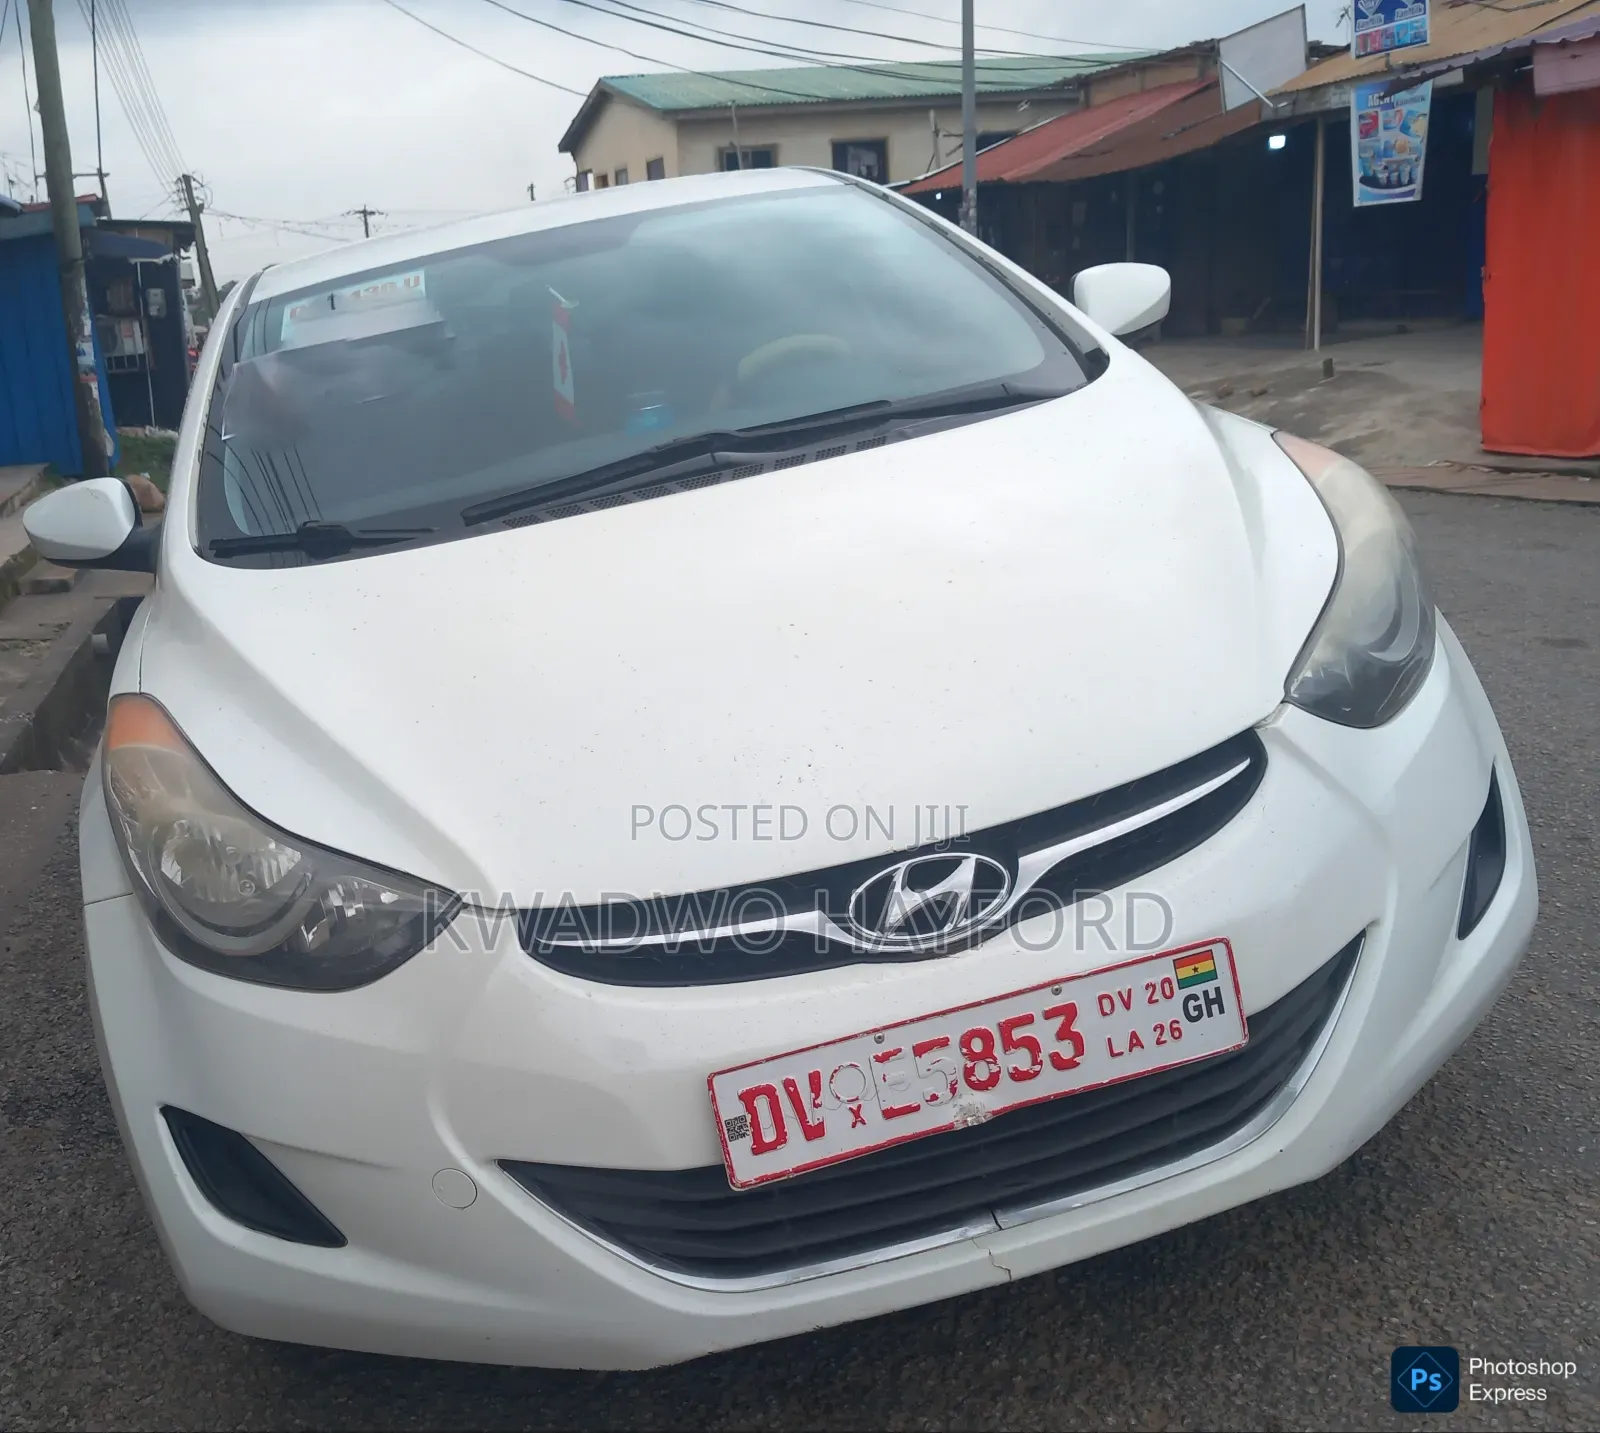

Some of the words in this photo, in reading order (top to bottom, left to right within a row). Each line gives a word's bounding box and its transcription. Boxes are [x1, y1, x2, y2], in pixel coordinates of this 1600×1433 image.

[1097, 987, 1133, 1017] DV
[1144, 976, 1175, 1005] 20
[1182, 985, 1226, 1023] GH
[1106, 1030, 1145, 1058] LA
[1153, 1019, 1183, 1046] 26
